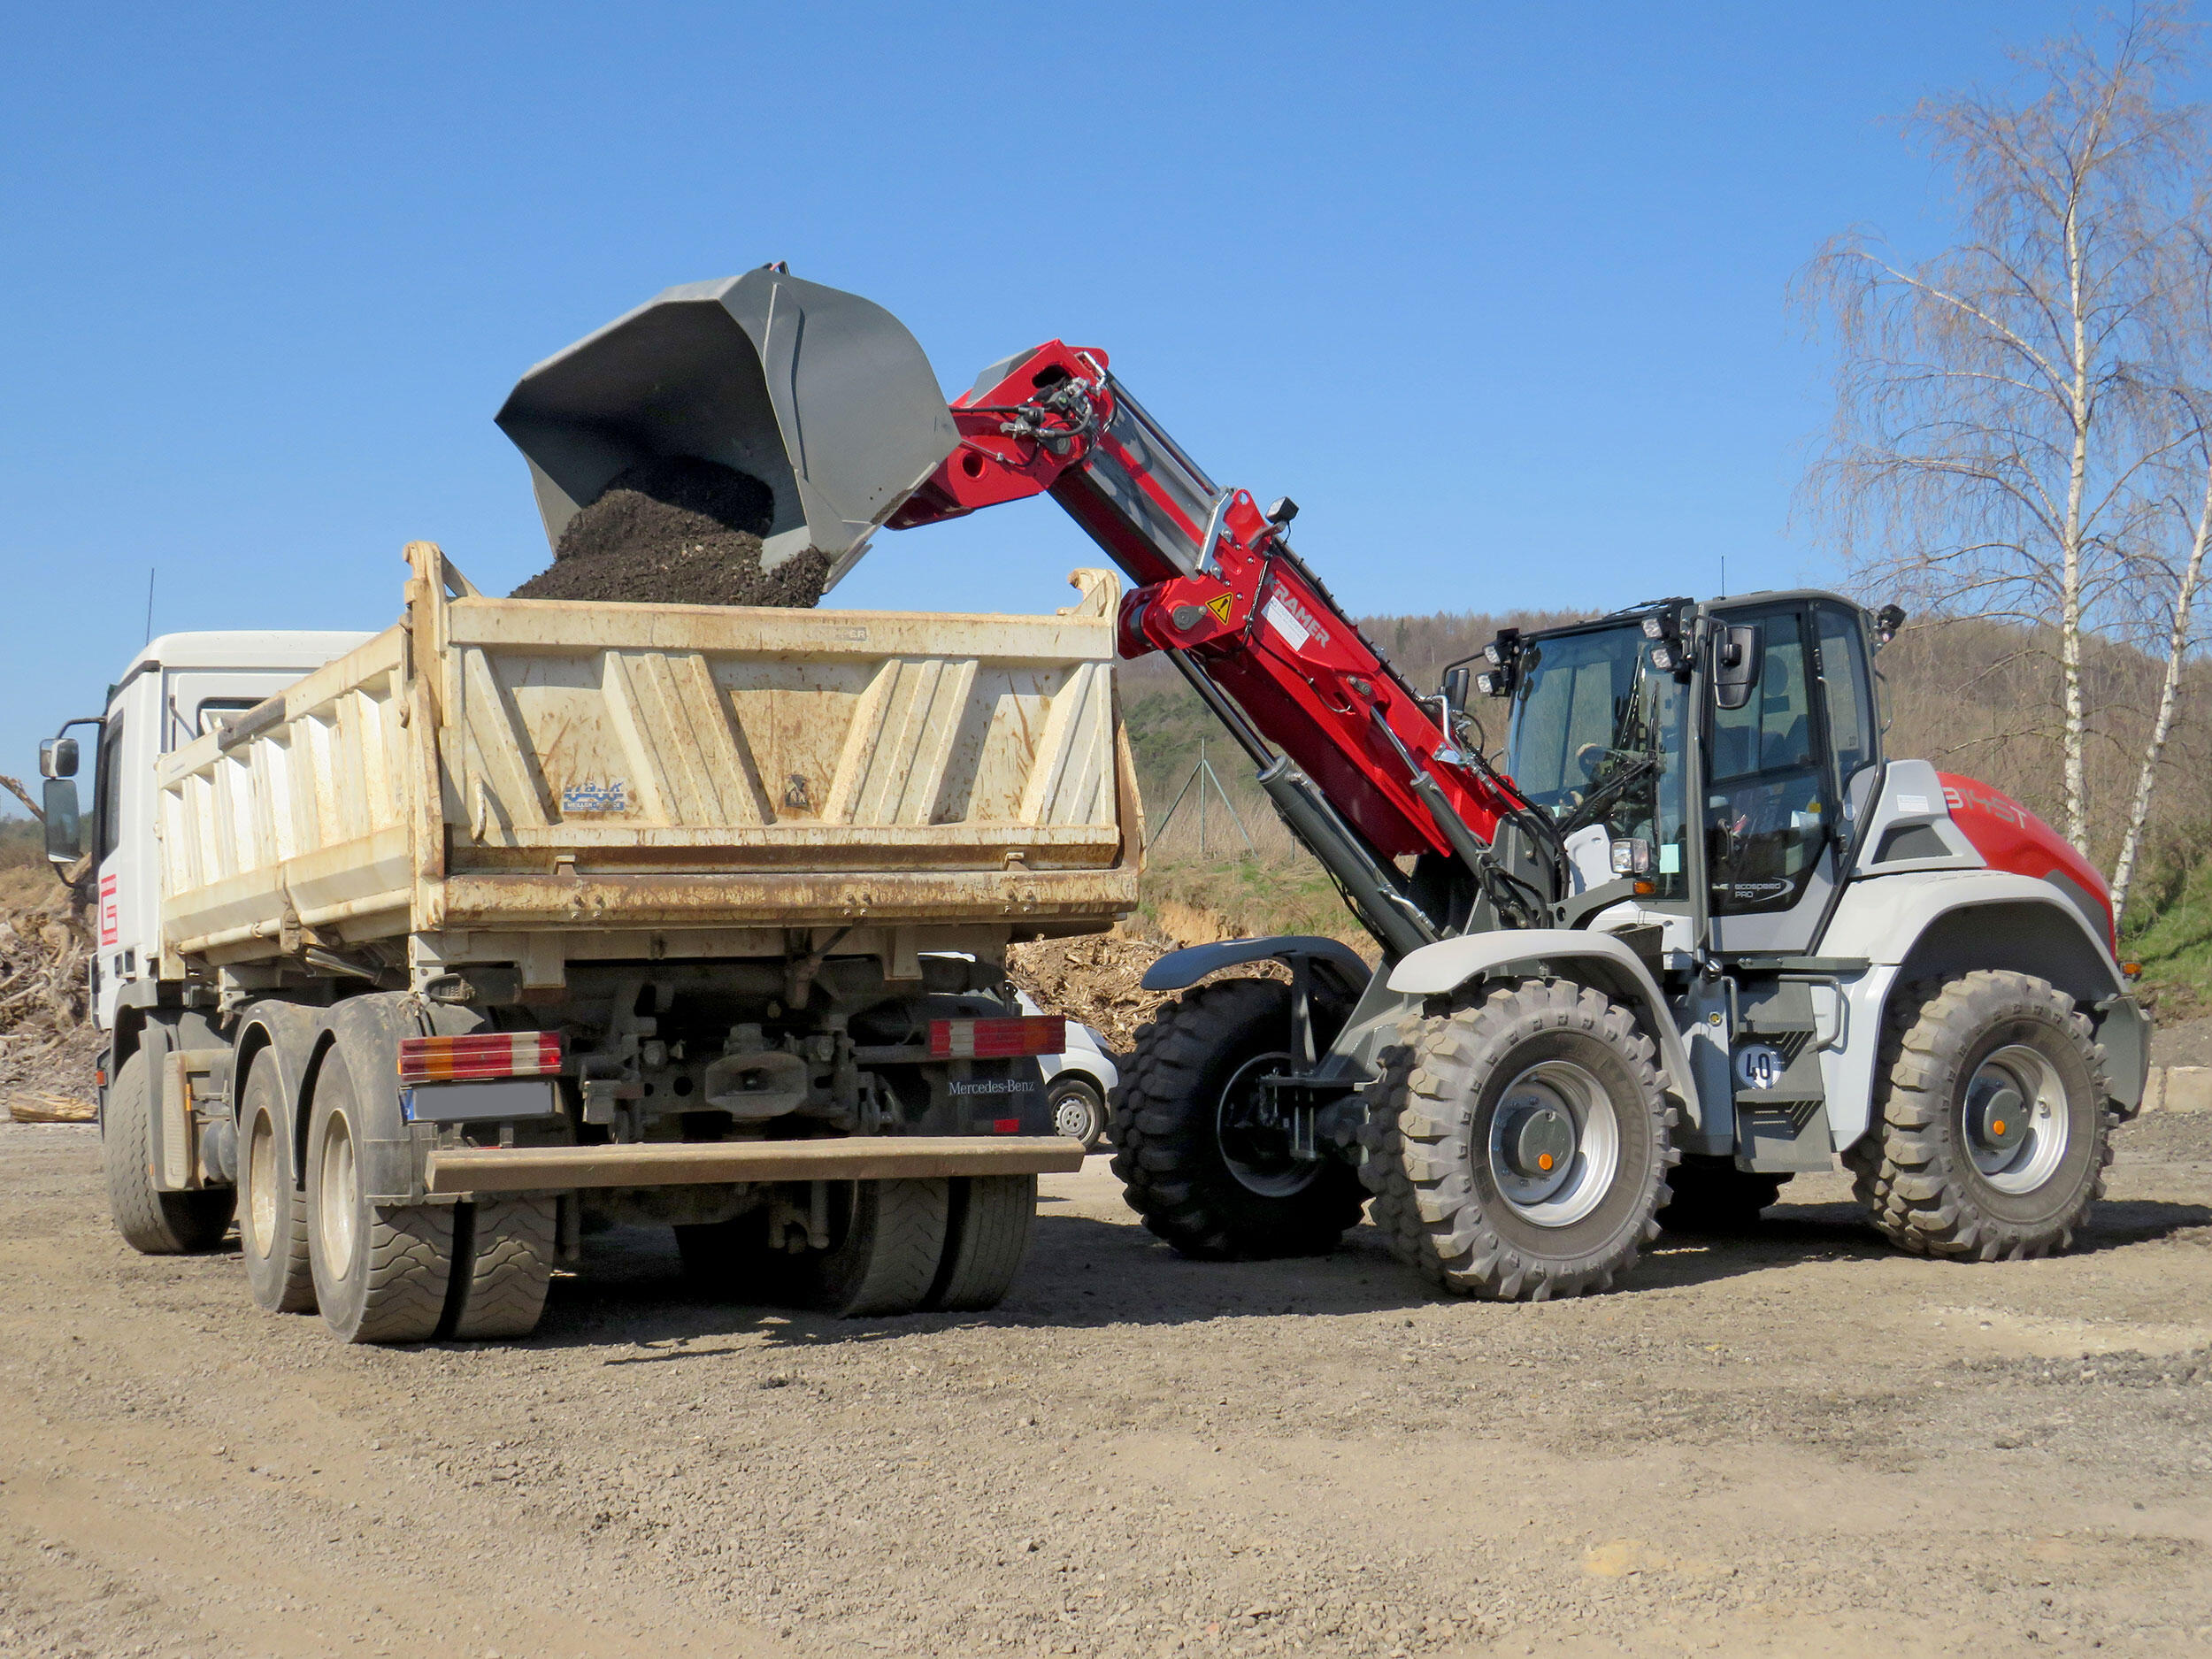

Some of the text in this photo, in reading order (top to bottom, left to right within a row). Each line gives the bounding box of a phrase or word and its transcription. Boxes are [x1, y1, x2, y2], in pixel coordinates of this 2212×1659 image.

[1263, 572, 1331, 649] KRAMER
[1746, 1053, 1771, 1080] 40
[948, 1079, 1035, 1096] Mercedes-Benz
